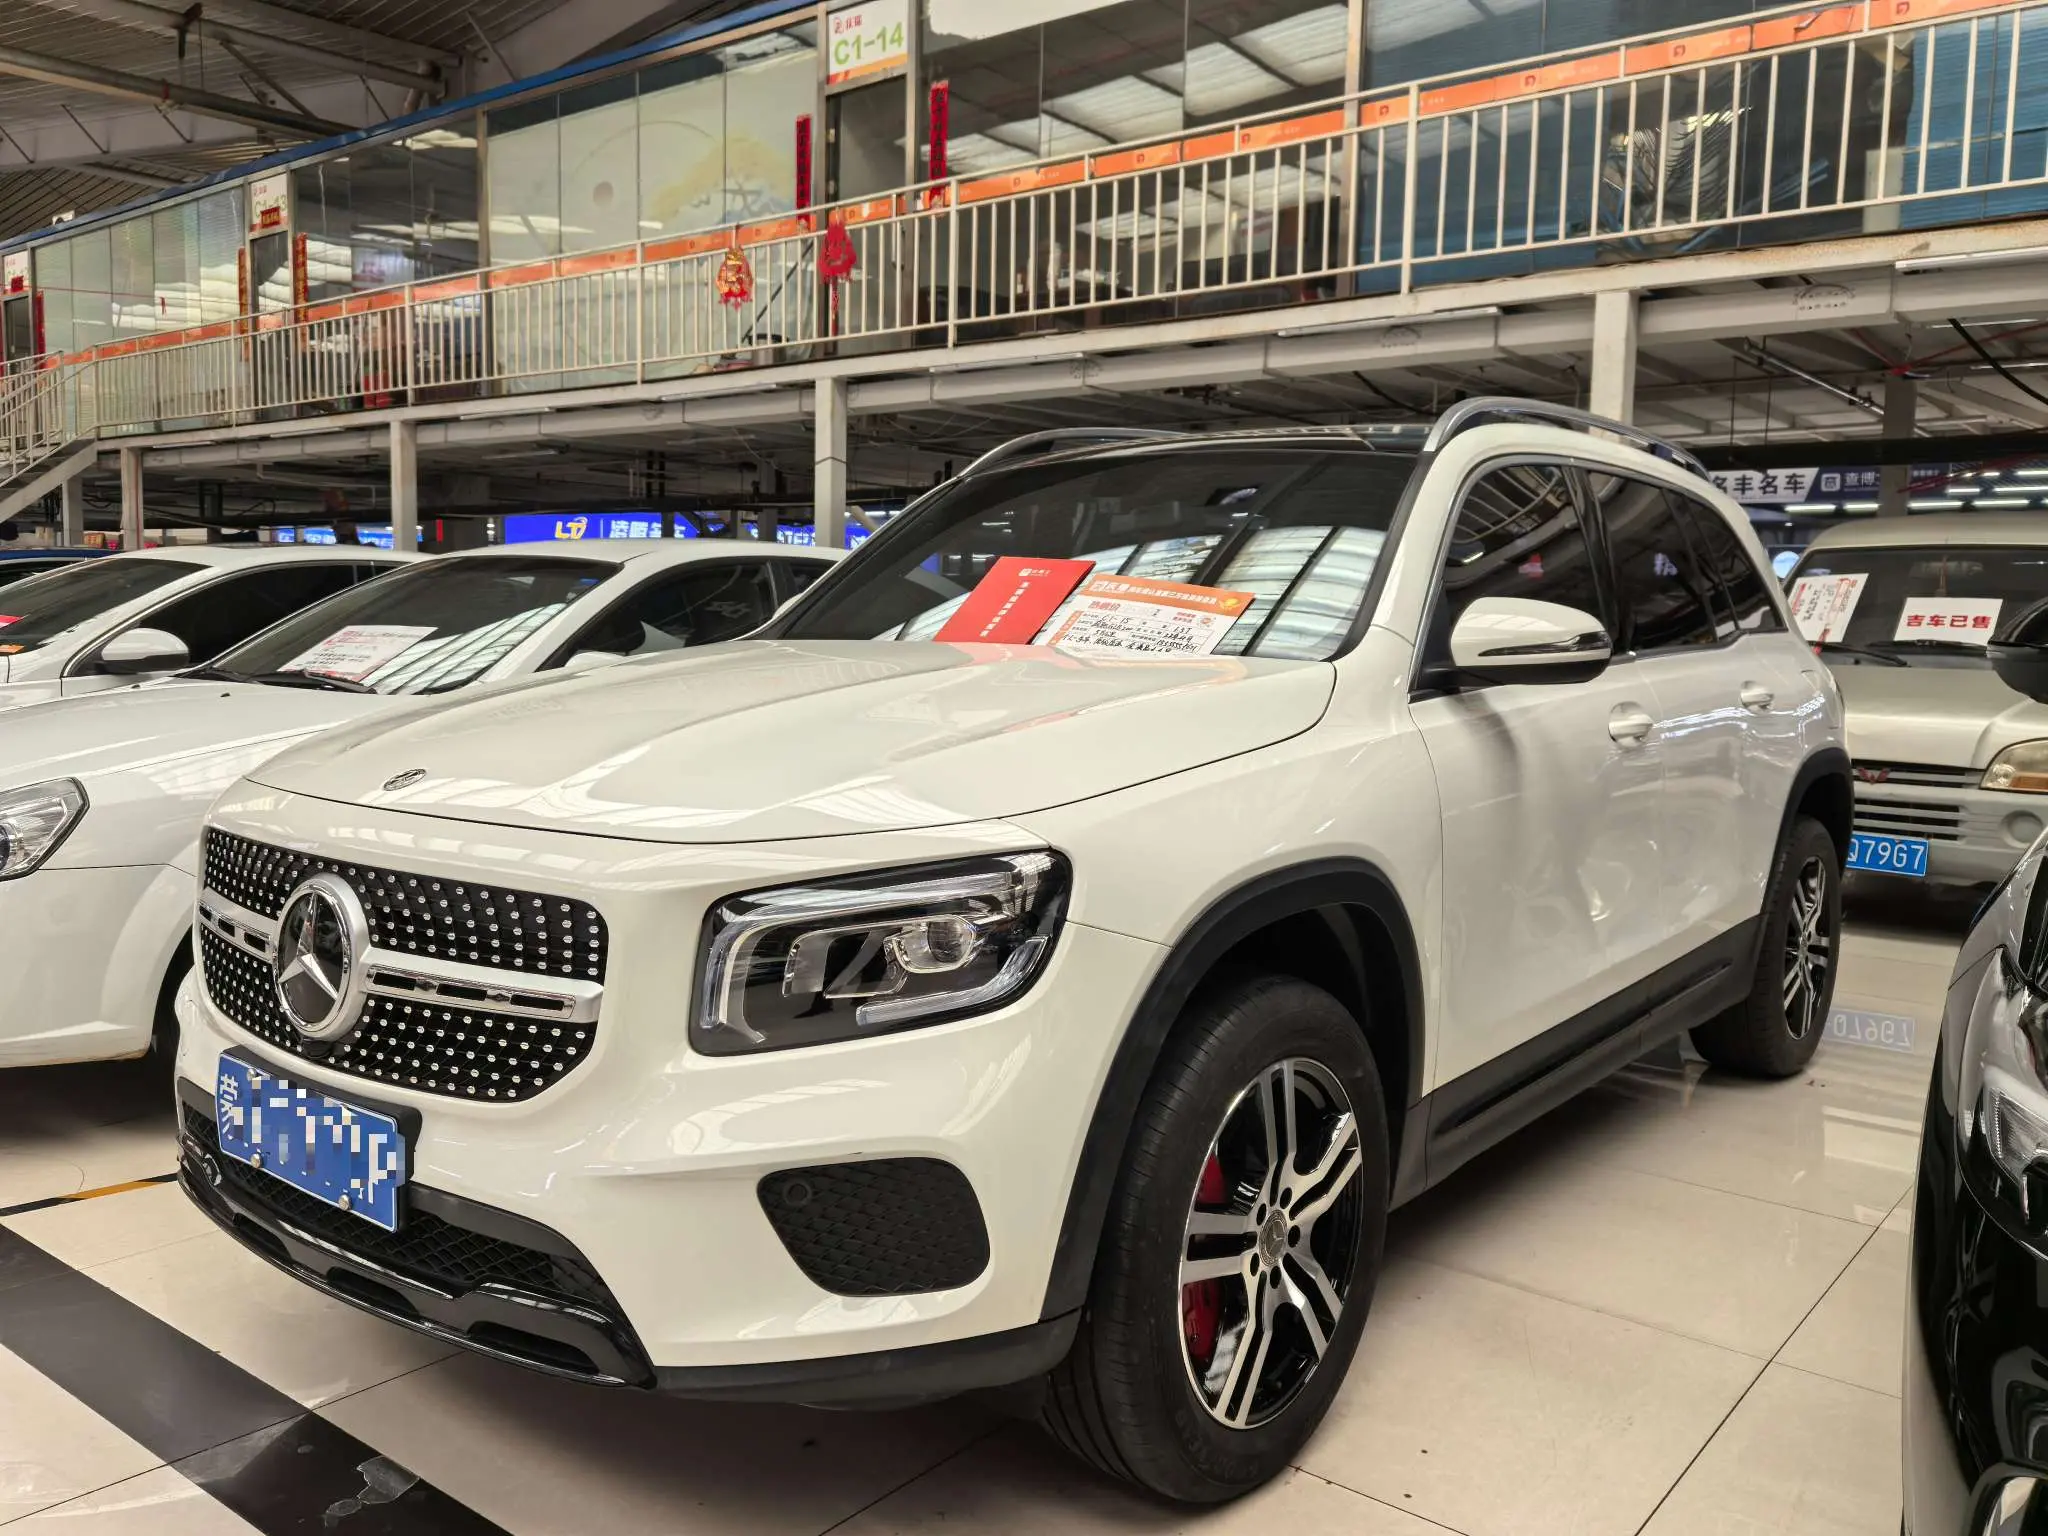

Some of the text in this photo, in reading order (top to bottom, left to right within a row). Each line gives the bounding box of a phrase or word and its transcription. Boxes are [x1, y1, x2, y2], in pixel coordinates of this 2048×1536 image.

[834, 21, 904, 65] C1-14
[1844, 472, 1880, 486] 查博
[1847, 838, 1925, 870] Q79G7
